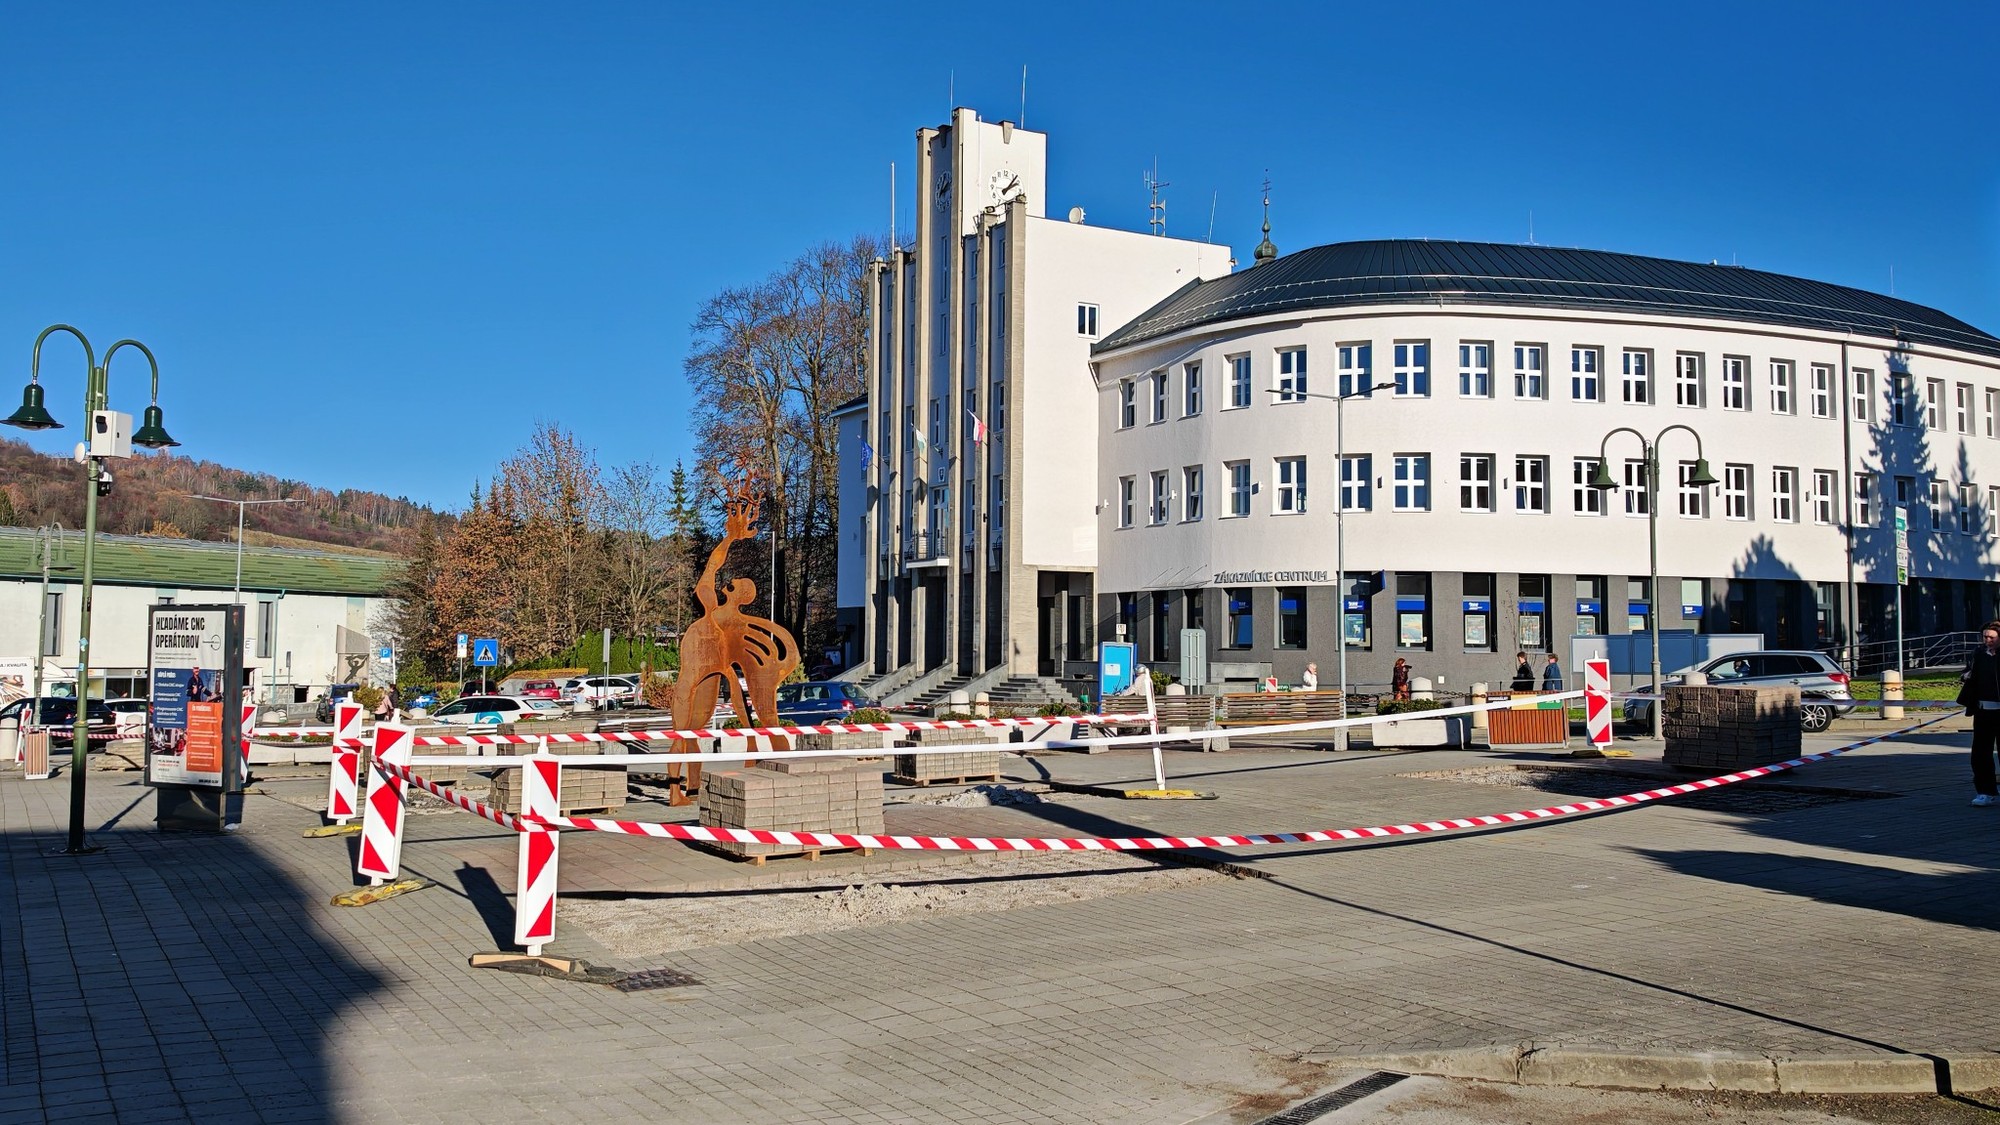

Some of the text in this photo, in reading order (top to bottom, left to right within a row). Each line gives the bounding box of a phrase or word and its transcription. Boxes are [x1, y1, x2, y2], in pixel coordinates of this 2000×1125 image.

[1214, 569, 1328, 584] ZÁKAZNÍCKE CENTRUM
[156, 614, 205, 631] HĽADÁME CNC
[155, 632, 200, 648] OPERÁTOROV
